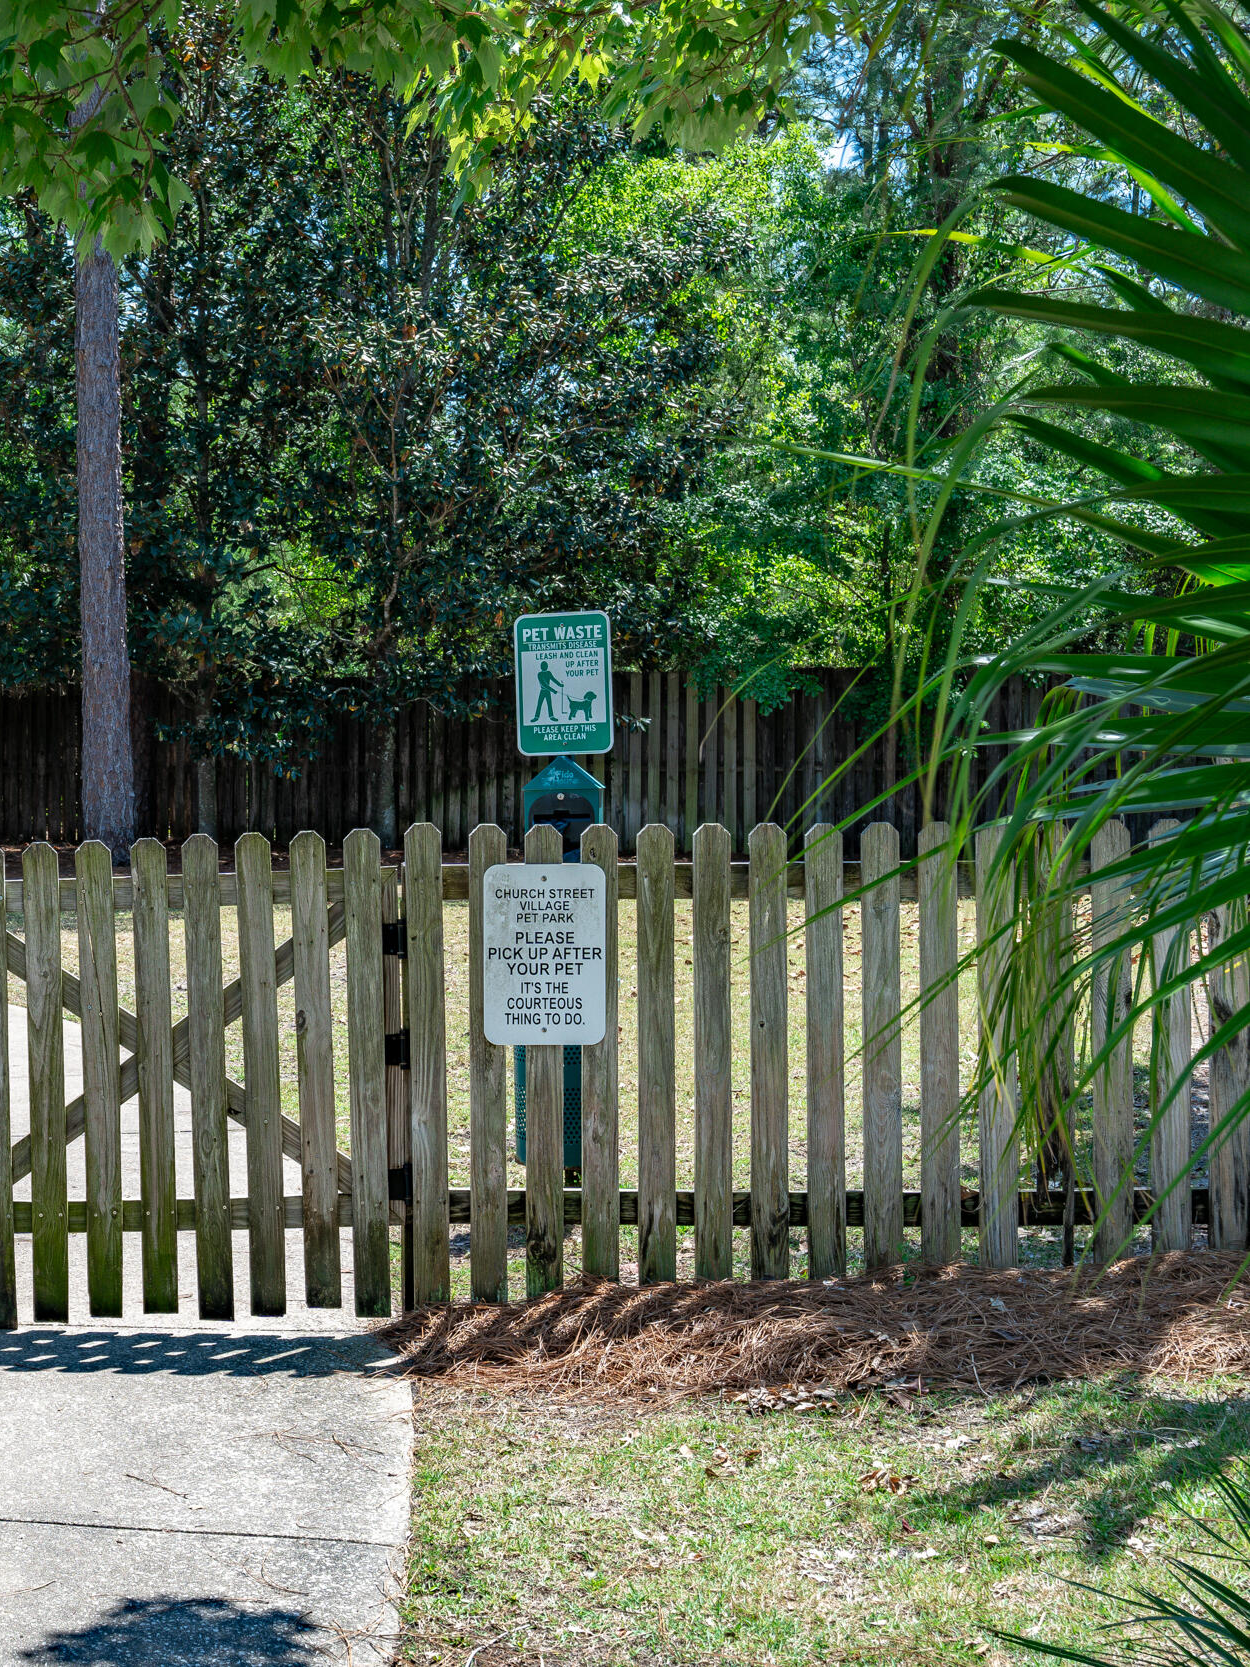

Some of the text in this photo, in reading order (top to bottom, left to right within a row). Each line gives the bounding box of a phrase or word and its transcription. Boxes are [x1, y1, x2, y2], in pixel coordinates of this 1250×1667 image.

[523, 625, 602, 641] PET WASTE
[529, 642, 566, 650] TRANSMITS
[496, 889, 594, 898] CHURCH STREET
[520, 901, 570, 910] VILLAGE
[517, 913, 574, 923] PET PARK
[516, 932, 574, 944] PLEASE
[489, 948, 602, 960] PICK UP AFTER
[507, 963, 583, 975] YOUR PET
[521, 982, 568, 994] IT'S THE
[507, 998, 582, 1009] COURTEOUS
[505, 1013, 585, 1025] THING TO DO.
